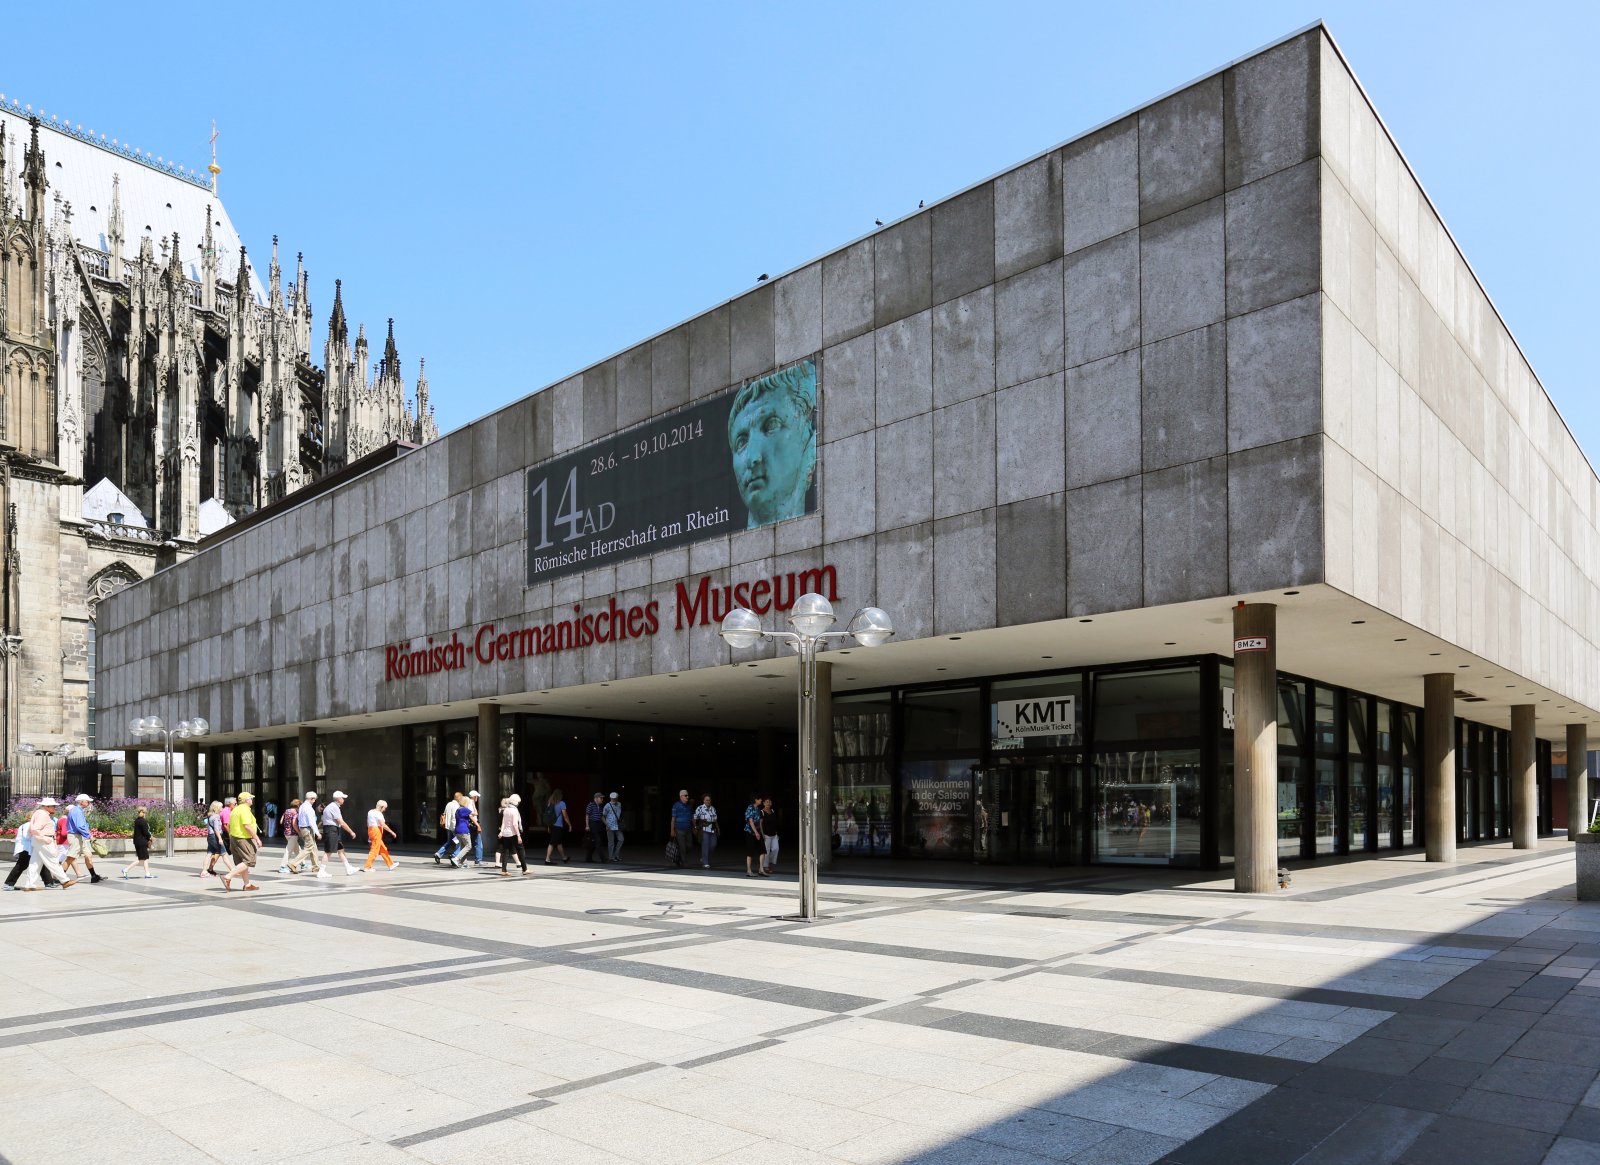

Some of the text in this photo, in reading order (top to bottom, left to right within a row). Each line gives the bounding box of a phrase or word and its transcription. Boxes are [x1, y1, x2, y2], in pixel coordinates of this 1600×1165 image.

[590, 451, 618, 476] 28.6.
[633, 419, 704, 460] 19.10.2014
[532, 465, 616, 551] 14 AD
[533, 506, 730, 574] Römische Herrschaft am Rhein
[384, 564, 840, 682] Römisch-Germanisches Museum
[1237, 640, 1255, 648] BMZ
[1015, 699, 1071, 725] KMT
[1015, 723, 1072, 733] KölnMusik Ticket
[911, 778, 970, 789] Willkommen
[911, 789, 970, 800] in der Saison
[918, 801, 962, 812] 2014/2015
